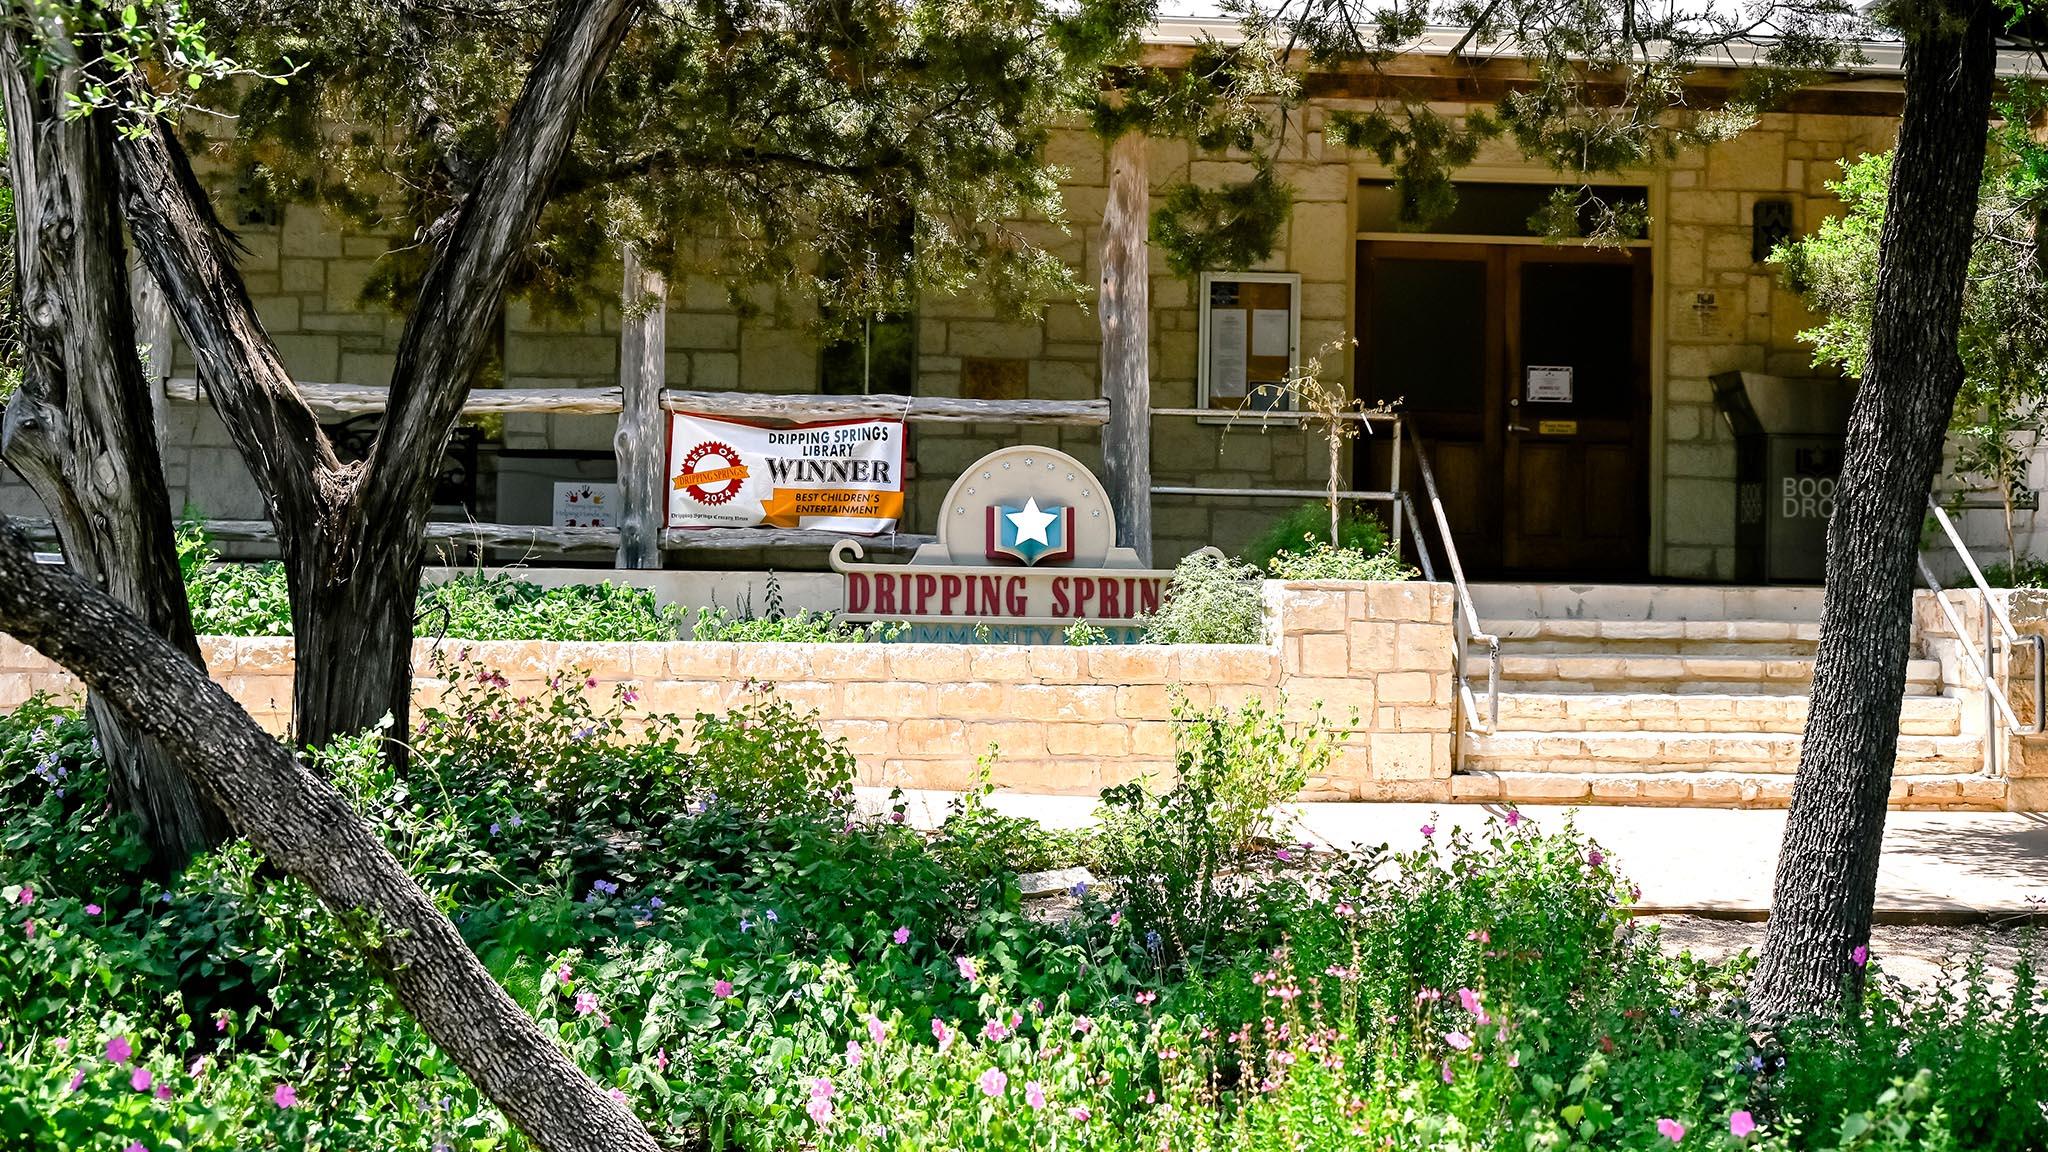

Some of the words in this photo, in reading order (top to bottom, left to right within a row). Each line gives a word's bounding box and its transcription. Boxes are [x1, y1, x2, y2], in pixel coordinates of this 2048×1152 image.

[769, 431, 830, 444] DRIPPING
[834, 426, 889, 443] SPRINGS
[687, 446, 712, 467] BEST
[719, 448, 735, 460] OF
[802, 443, 855, 457] LIBRARY
[679, 472, 713, 486] DRIPPING
[714, 467, 744, 480] SPRINGS
[765, 457, 891, 484] WINNER
[704, 490, 731, 502] 2024
[1783, 477, 1835, 498] BOO
[795, 493, 819, 502] BEST
[820, 493, 880, 503] CHILDREN'S
[1783, 497, 1834, 518] DRO
[795, 505, 879, 514] ENTERTAINMENT
[848, 572, 1028, 617] DRIPPING
[1051, 576, 1164, 619] SPRIN
